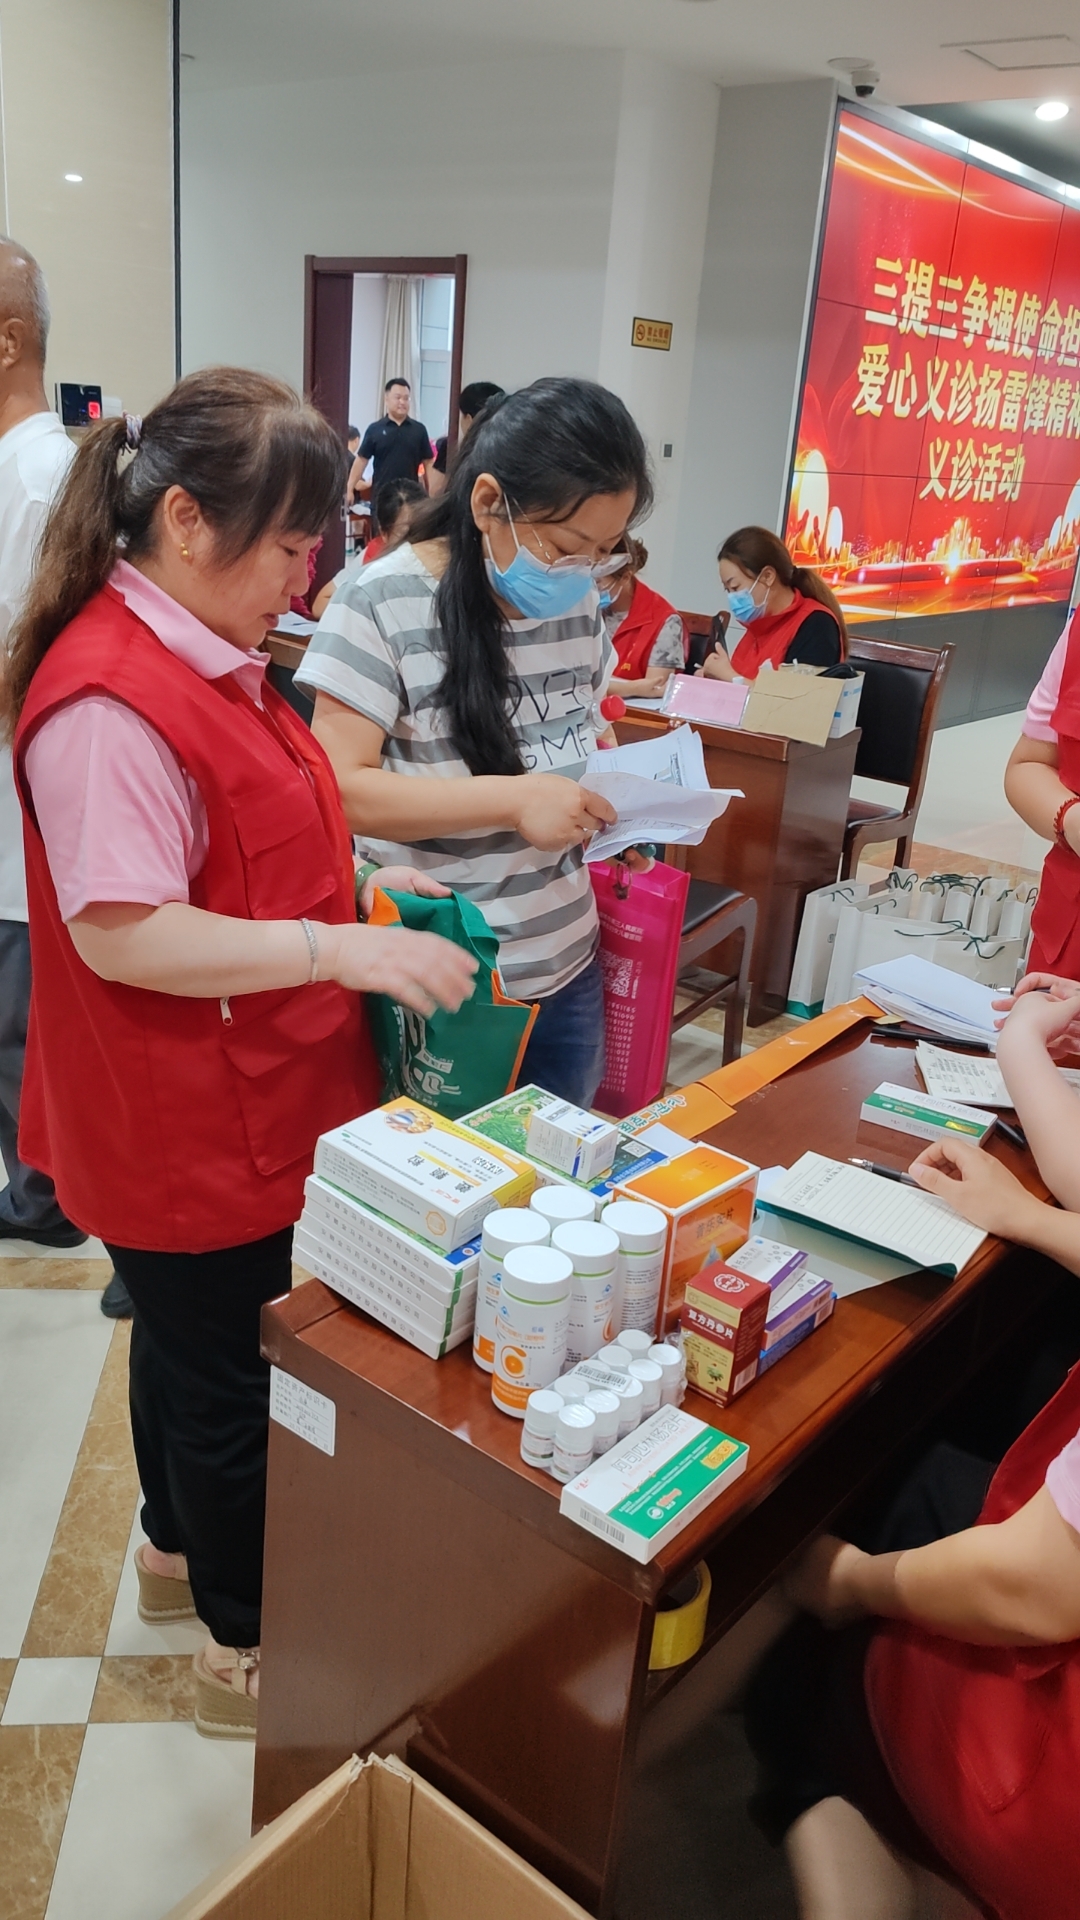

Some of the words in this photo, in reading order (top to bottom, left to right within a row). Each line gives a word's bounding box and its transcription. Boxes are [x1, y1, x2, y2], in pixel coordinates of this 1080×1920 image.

[920, 437, 1027, 503] 义诊活动
[688, 1307, 734, 1341] 复方丹参片
[611, 1413, 688, 1475] 阿司匹林肠溶片
